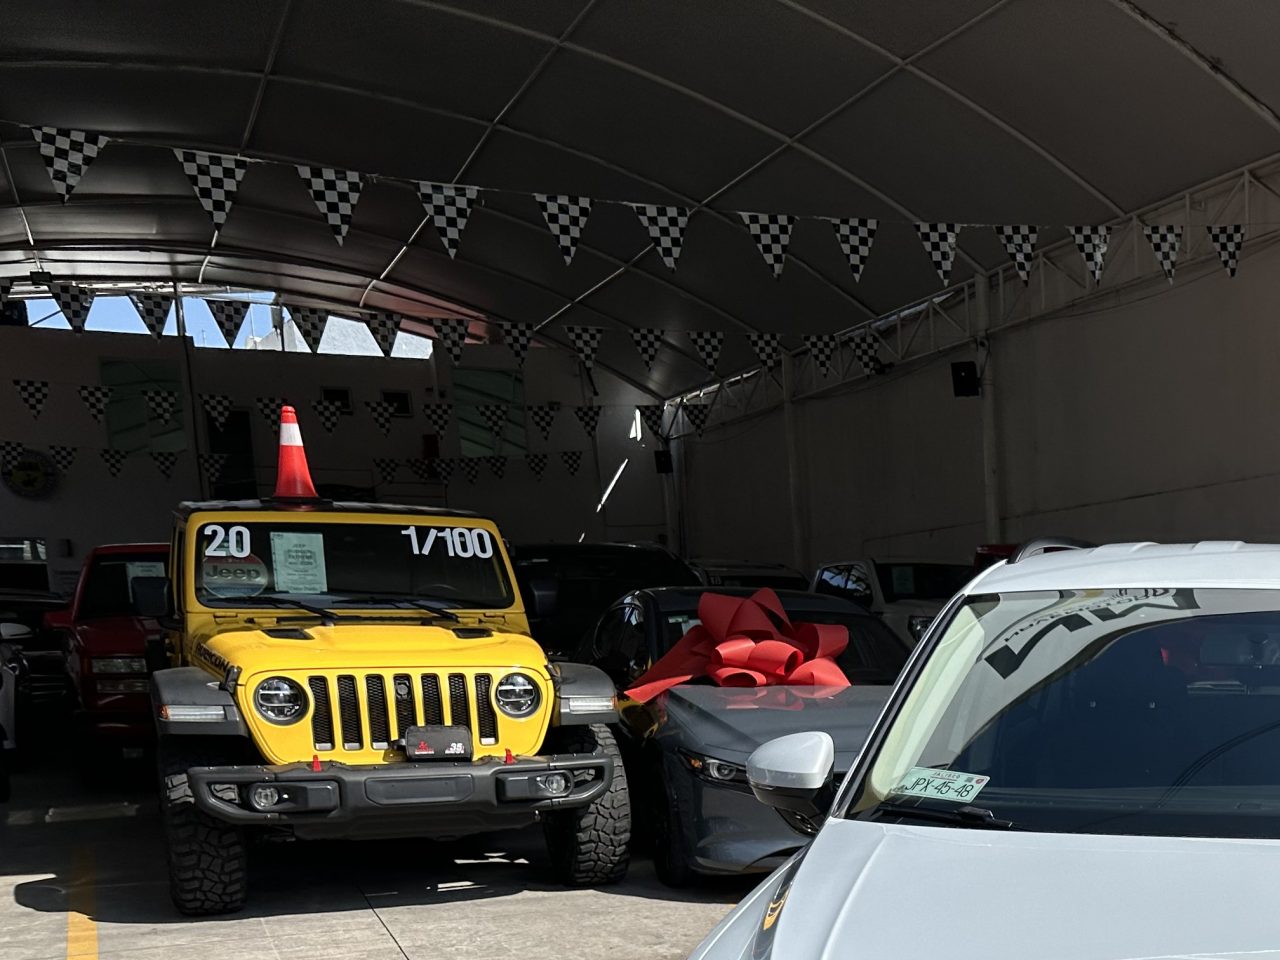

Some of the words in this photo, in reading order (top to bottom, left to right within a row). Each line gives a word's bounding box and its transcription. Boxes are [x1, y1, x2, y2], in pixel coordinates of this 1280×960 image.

[203, 524, 251, 559] 20
[401, 525, 494, 559] 1/100
[204, 564, 261, 581] Jeep
[904, 777, 975, 798] JPX-45-48
